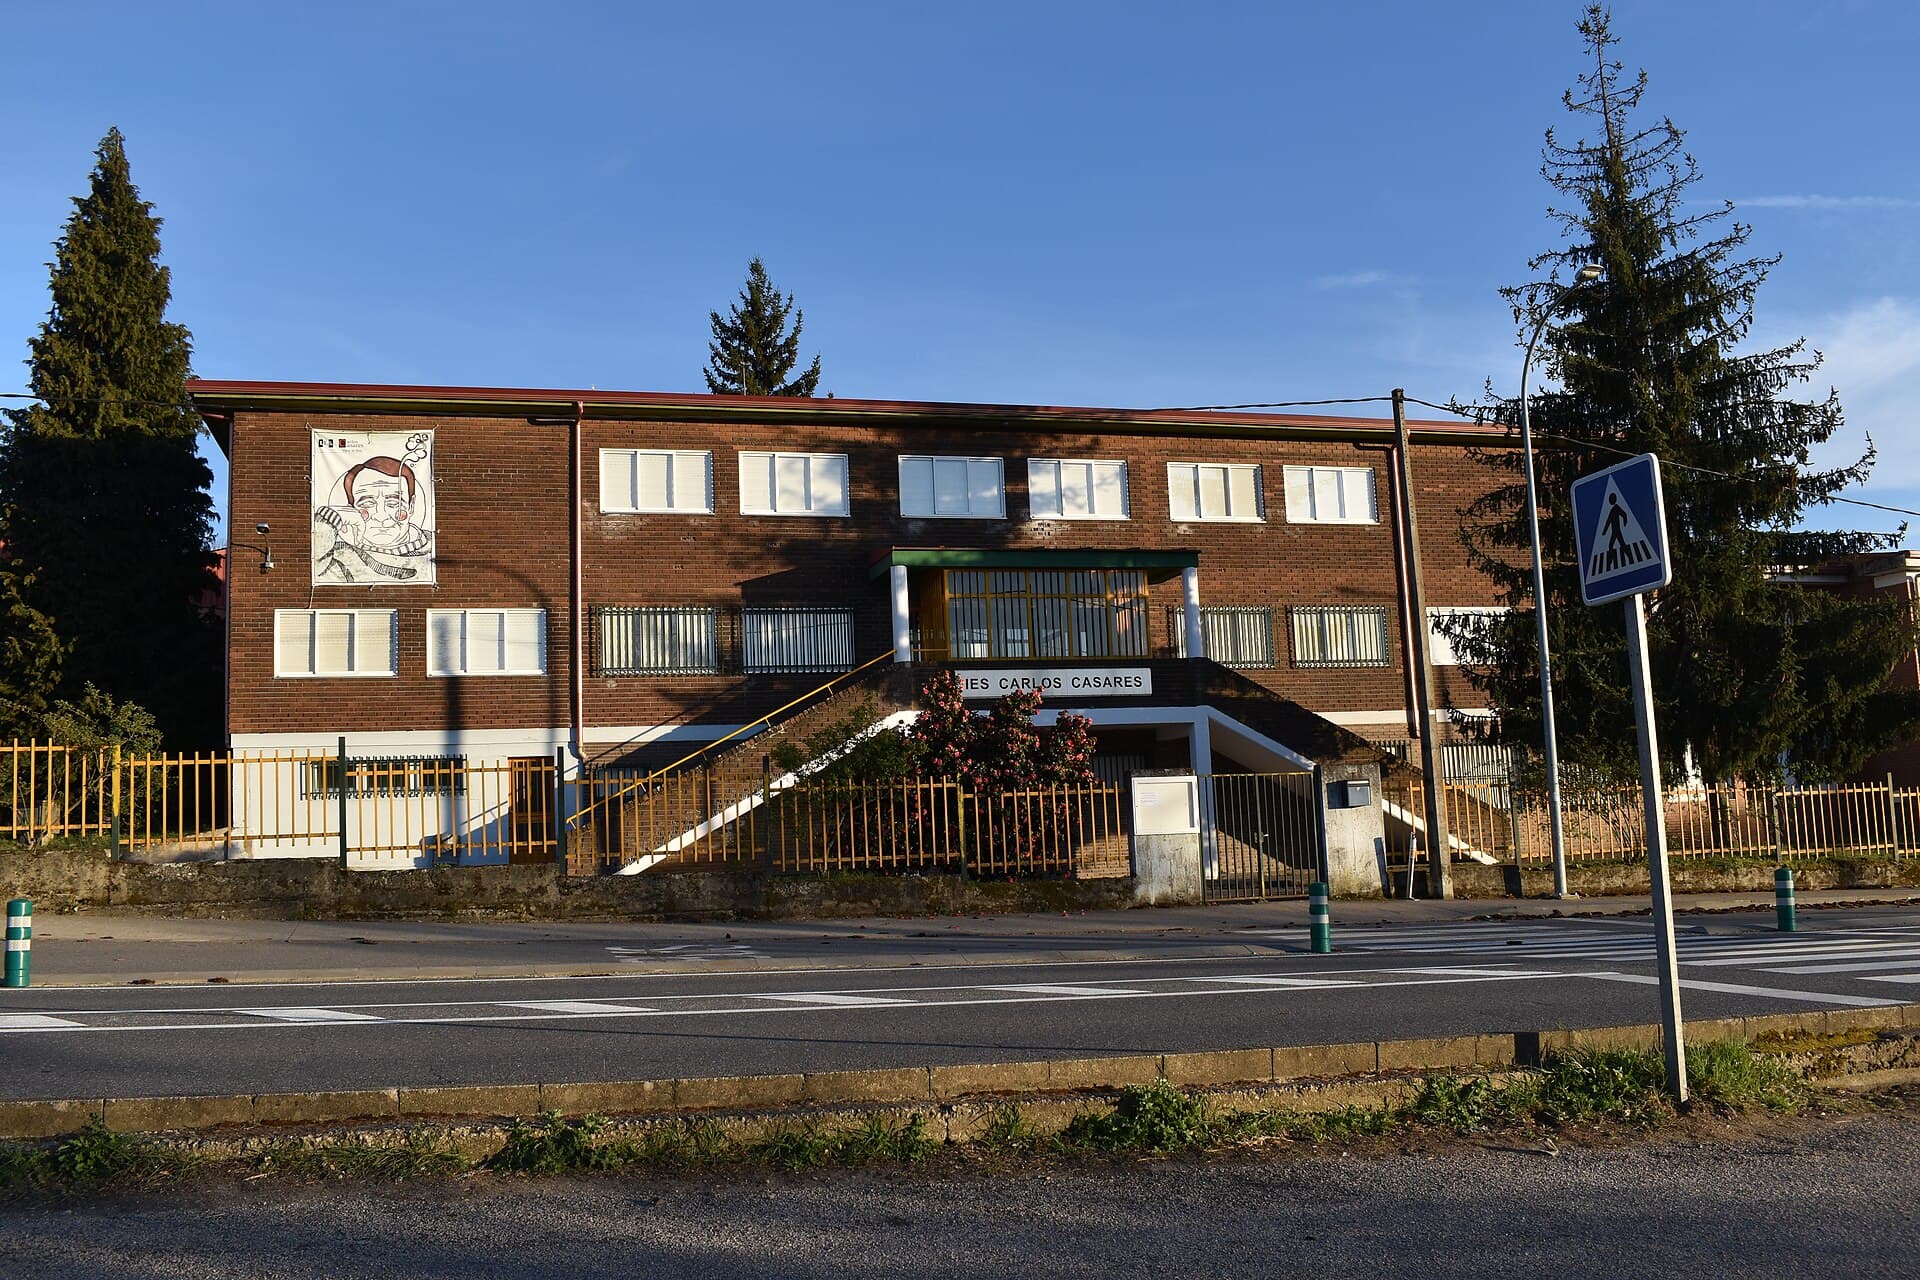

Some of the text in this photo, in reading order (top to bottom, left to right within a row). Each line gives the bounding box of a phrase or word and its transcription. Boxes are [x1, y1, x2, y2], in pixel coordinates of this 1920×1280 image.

[965, 676, 1143, 690] IES CARLOS CASARES
